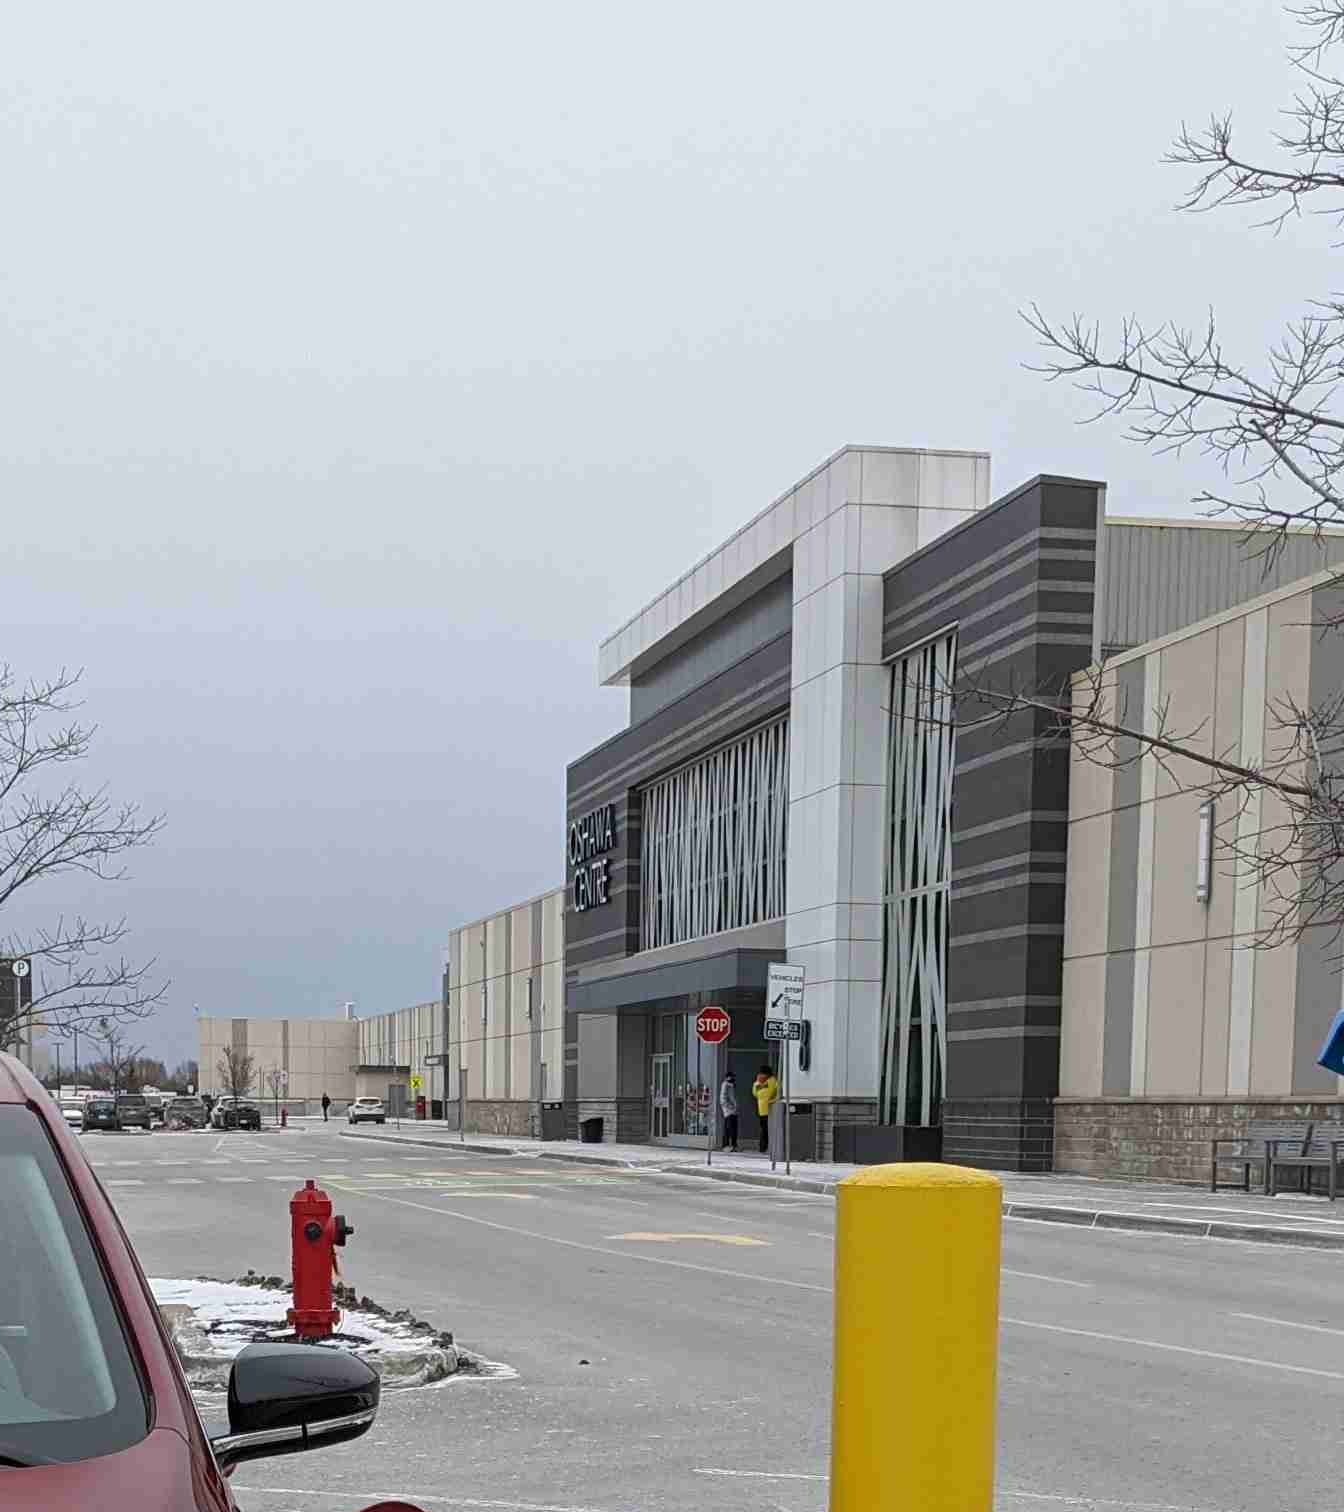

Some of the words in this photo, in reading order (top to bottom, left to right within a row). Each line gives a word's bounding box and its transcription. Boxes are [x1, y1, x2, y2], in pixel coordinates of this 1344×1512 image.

[569, 804, 615, 865] OSHAWA
[575, 859, 608, 912] CENTRE
[697, 1018, 728, 1032] STOP
[768, 1021, 798, 1031] BICYES
[768, 1030, 799, 1039] EXCEED
